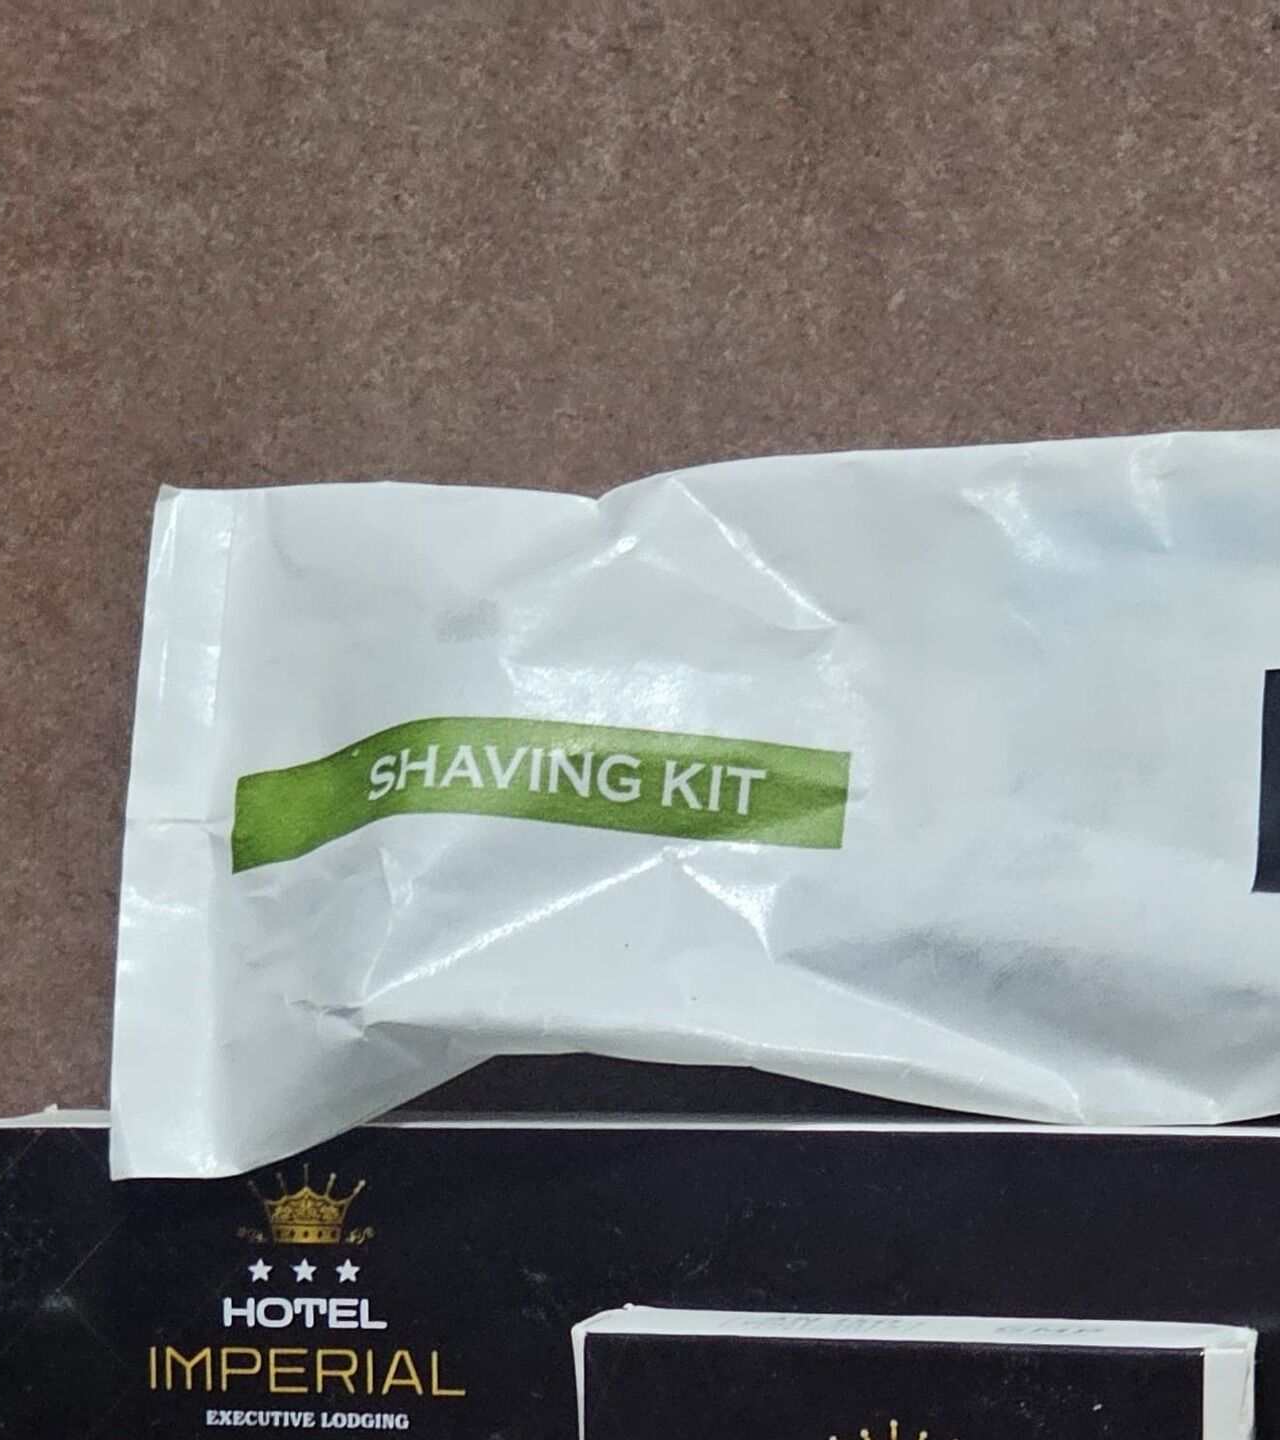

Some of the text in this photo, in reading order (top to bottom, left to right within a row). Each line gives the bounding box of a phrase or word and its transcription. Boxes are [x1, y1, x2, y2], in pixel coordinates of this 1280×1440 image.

[368, 744, 766, 816] SHAVING KIT
[223, 1297, 388, 1330] HOTEL
[149, 1346, 466, 1397] IMPERIAL
[206, 1410, 409, 1430] EXECUTIVE LODGING
